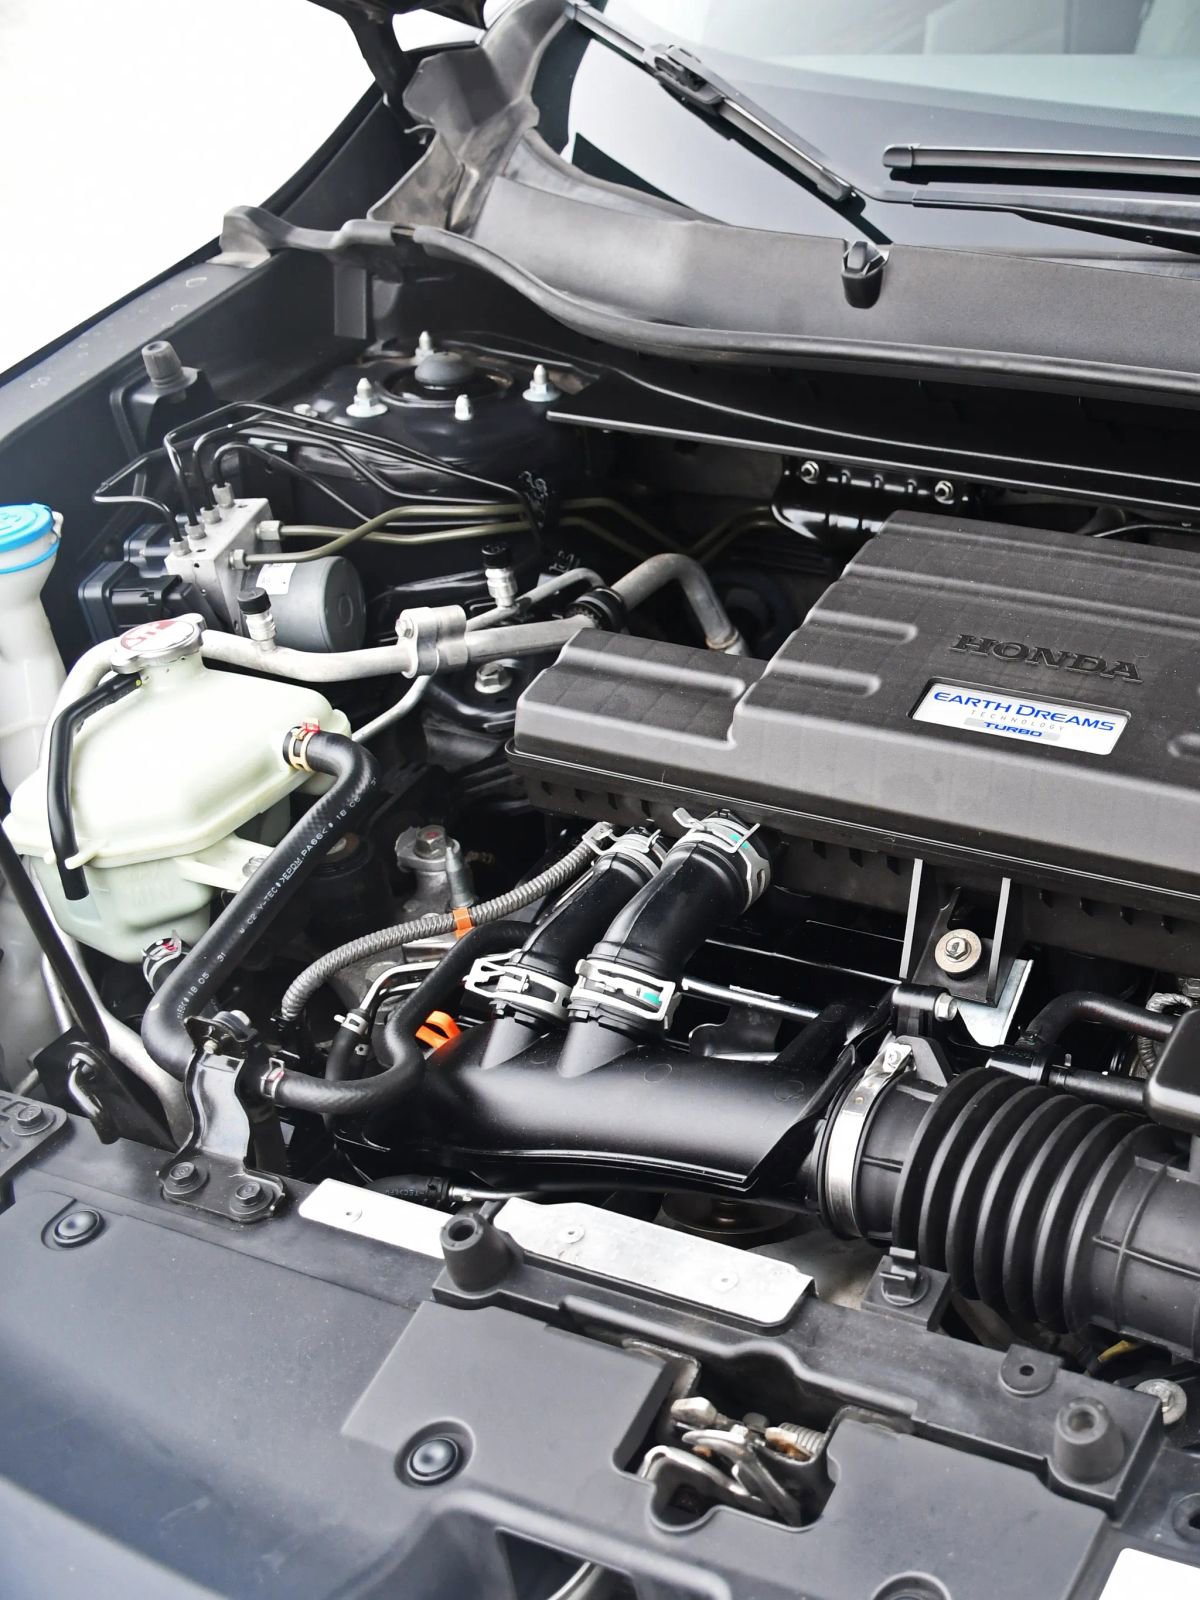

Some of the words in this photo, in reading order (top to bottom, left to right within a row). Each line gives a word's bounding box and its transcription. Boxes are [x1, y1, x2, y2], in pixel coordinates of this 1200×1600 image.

[950, 634, 1143, 683] HONDA
[933, 691, 1012, 713] EARTH
[1016, 704, 1116, 732] DREAMS
[971, 709, 1064, 731] TECHNOLOGY
[984, 721, 1043, 737] TURBO
